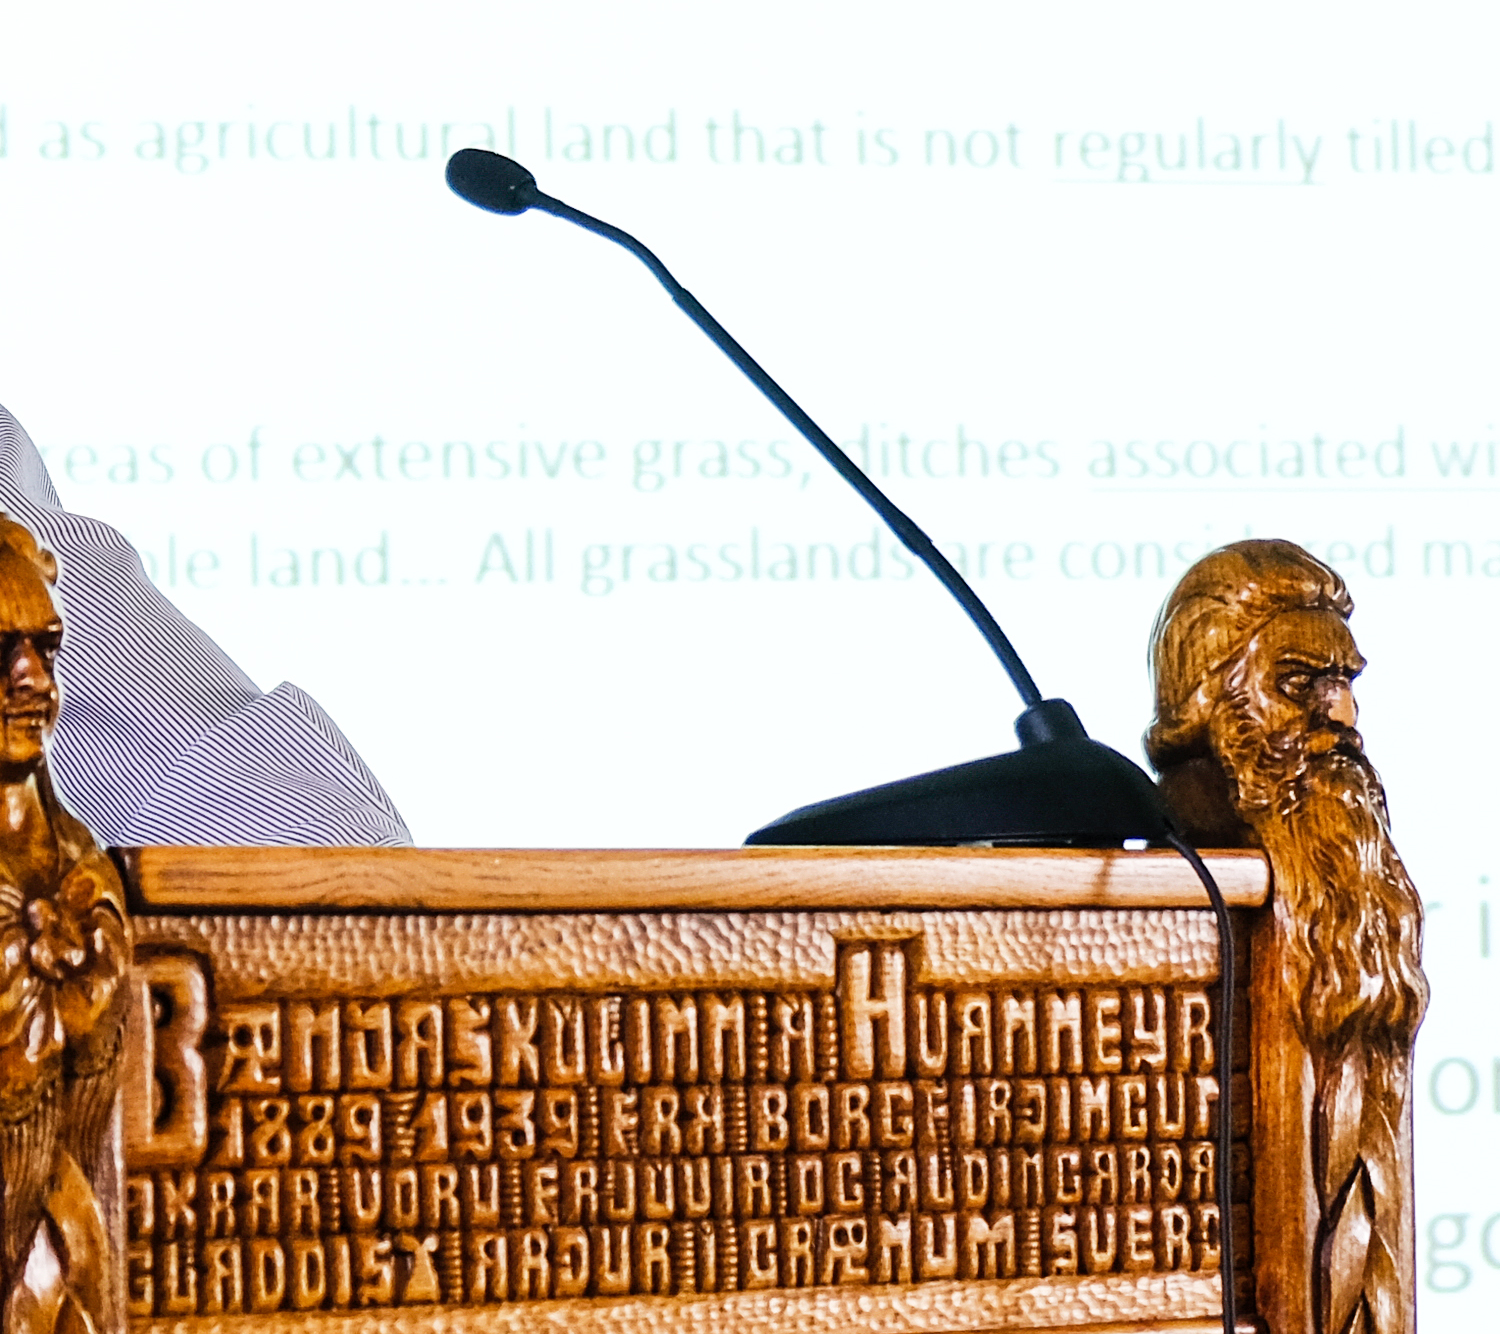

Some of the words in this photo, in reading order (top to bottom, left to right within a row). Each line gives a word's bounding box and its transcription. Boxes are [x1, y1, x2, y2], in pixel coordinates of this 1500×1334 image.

[36, 119, 109, 163] as
[131, 98, 519, 174] agricultural
[542, 105, 681, 165] land
[703, 108, 829, 168] that
[855, 108, 902, 168] is
[922, 121, 1023, 169] not
[1052, 115, 1325, 188] regularly
[1344, 118, 1497, 176] tilled
[198, 424, 265, 484] of
[289, 420, 609, 482] extensive
[628, 431, 814, 495] grass,
[1085, 423, 1409, 481] associated
[473, 526, 557, 586] All
[579, 522, 918, 601] grasslands
[222, 1095, 382, 1164] 1889
[414, 1087, 577, 1159] 1939
